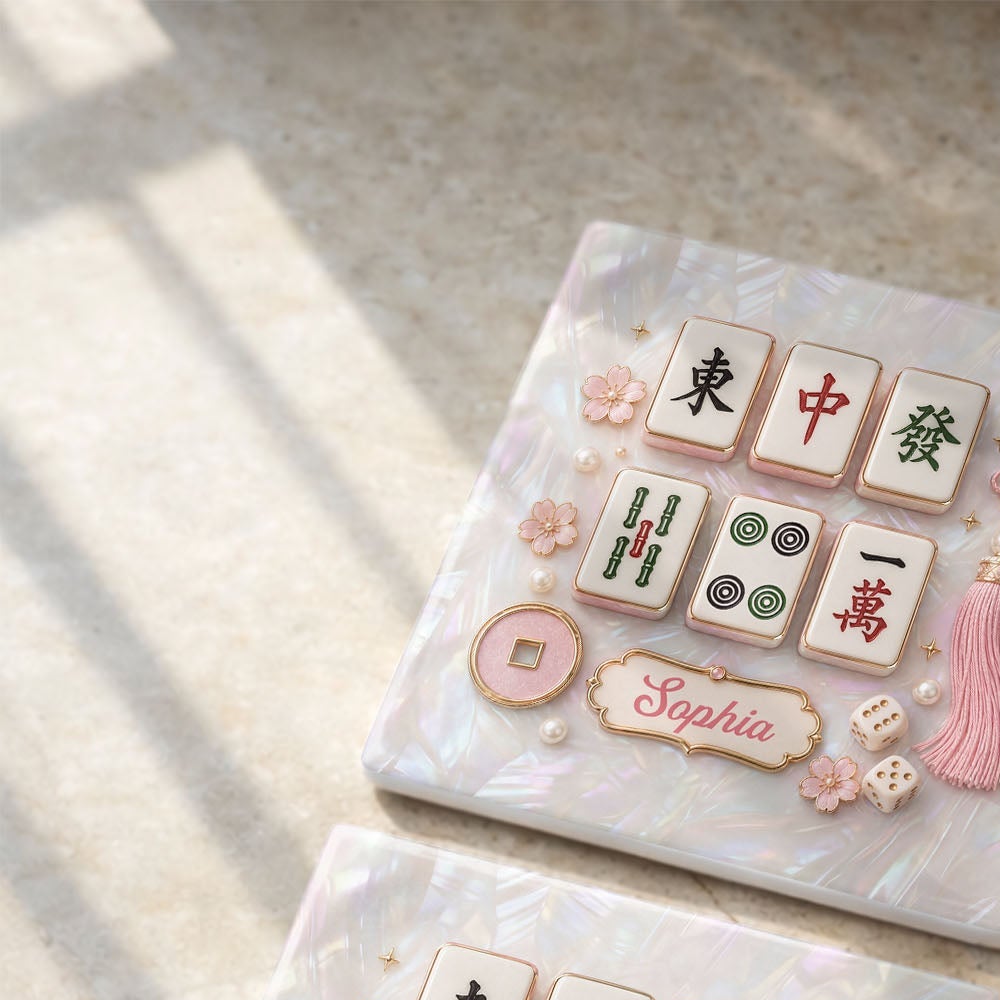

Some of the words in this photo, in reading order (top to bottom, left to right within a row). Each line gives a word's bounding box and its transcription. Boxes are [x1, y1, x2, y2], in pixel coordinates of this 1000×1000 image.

[670, 346, 735, 417] 東
[798, 372, 851, 446] 中
[891, 404, 962, 473] 發
[633, 675, 775, 742] Sophia
